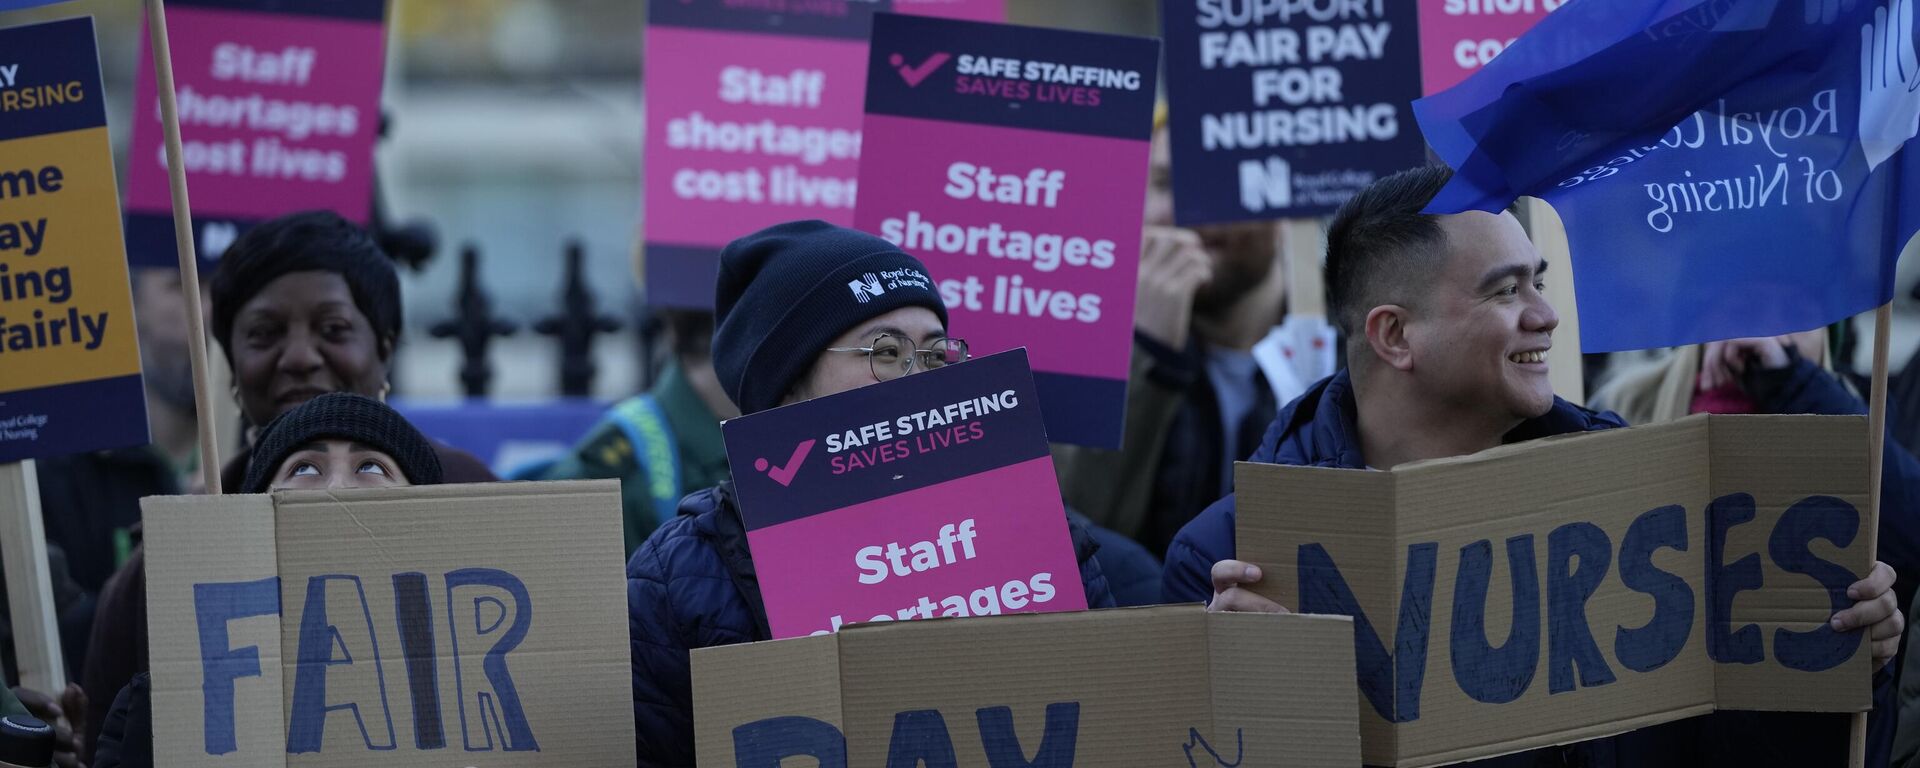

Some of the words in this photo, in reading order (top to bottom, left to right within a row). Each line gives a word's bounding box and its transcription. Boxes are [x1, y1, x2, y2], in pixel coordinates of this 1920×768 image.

[212, 43, 315, 86] Staff
[1200, 29, 1300, 69] FAIR
[1306, 22, 1391, 62] PAY
[1453, 38, 1518, 69] co
[718, 66, 825, 108] Staff
[955, 76, 1030, 100] SAVES
[1036, 84, 1102, 106] LIVES
[957, 55, 1020, 79] SAFE
[1023, 61, 1141, 91] STAFFING
[1252, 67, 1343, 106] FOR
[1201, 103, 1398, 150] NURSING
[0, 165, 64, 199] me
[252, 138, 346, 183] lives
[673, 167, 765, 204] cost
[945, 161, 1065, 207] Staff
[0, 218, 47, 256] ay
[880, 211, 1116, 271] shortages
[0, 263, 72, 303] ing
[941, 276, 984, 311] st
[993, 274, 1102, 323] lives
[825, 420, 893, 454] SAFE
[897, 389, 1018, 436] STAFFING
[831, 440, 910, 475] SAVES
[916, 421, 985, 454] LIVES
[855, 518, 977, 585] Staff
[1298, 492, 1861, 723] NURSES
[193, 567, 541, 757] FAIR
